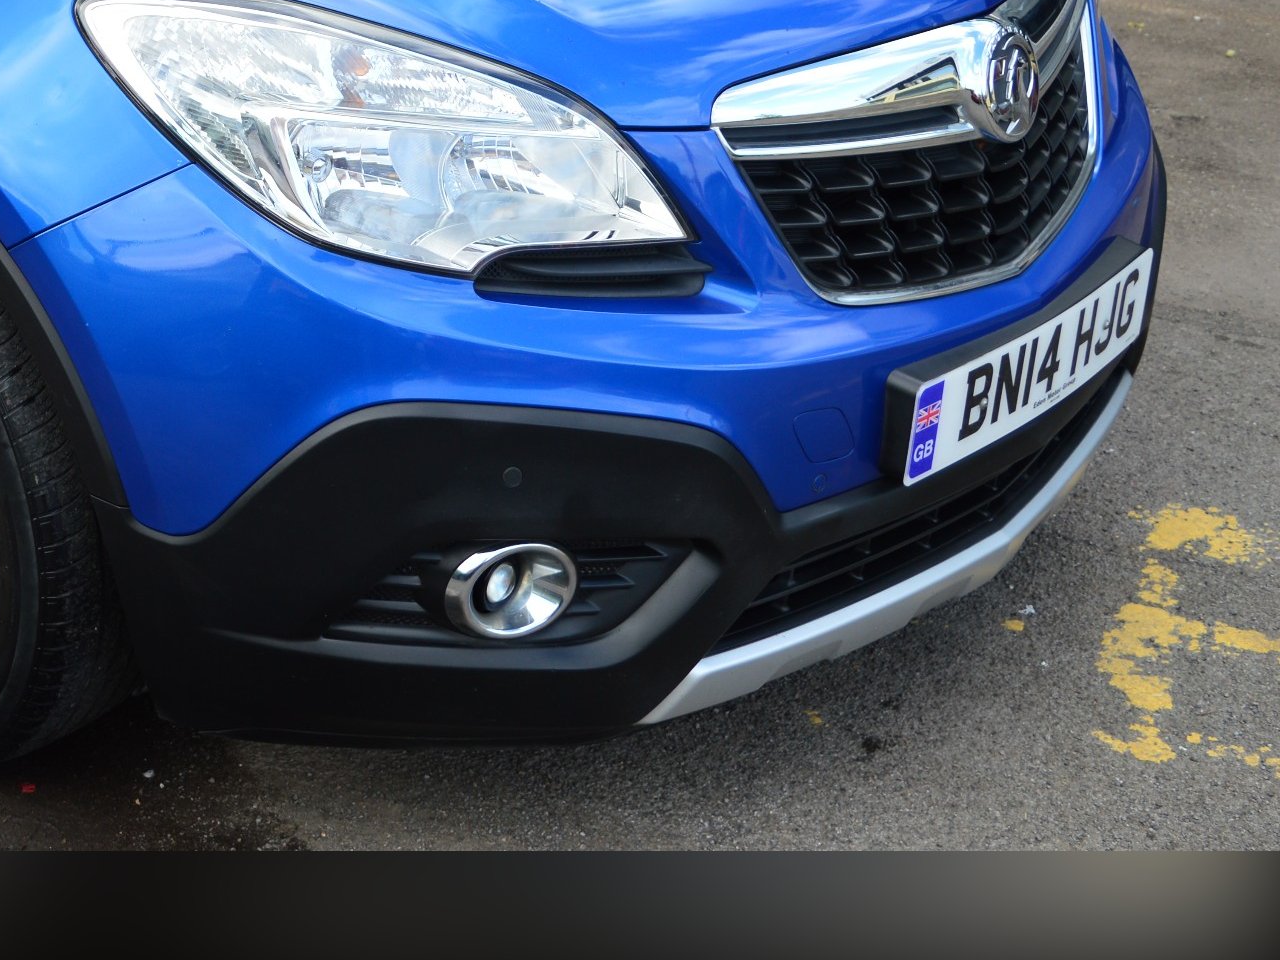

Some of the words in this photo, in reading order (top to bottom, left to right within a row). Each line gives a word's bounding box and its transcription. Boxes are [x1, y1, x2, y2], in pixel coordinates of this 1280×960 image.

[957, 322, 1064, 442] BN14
[1069, 268, 1140, 378] HJG
[913, 438, 934, 463] GB
